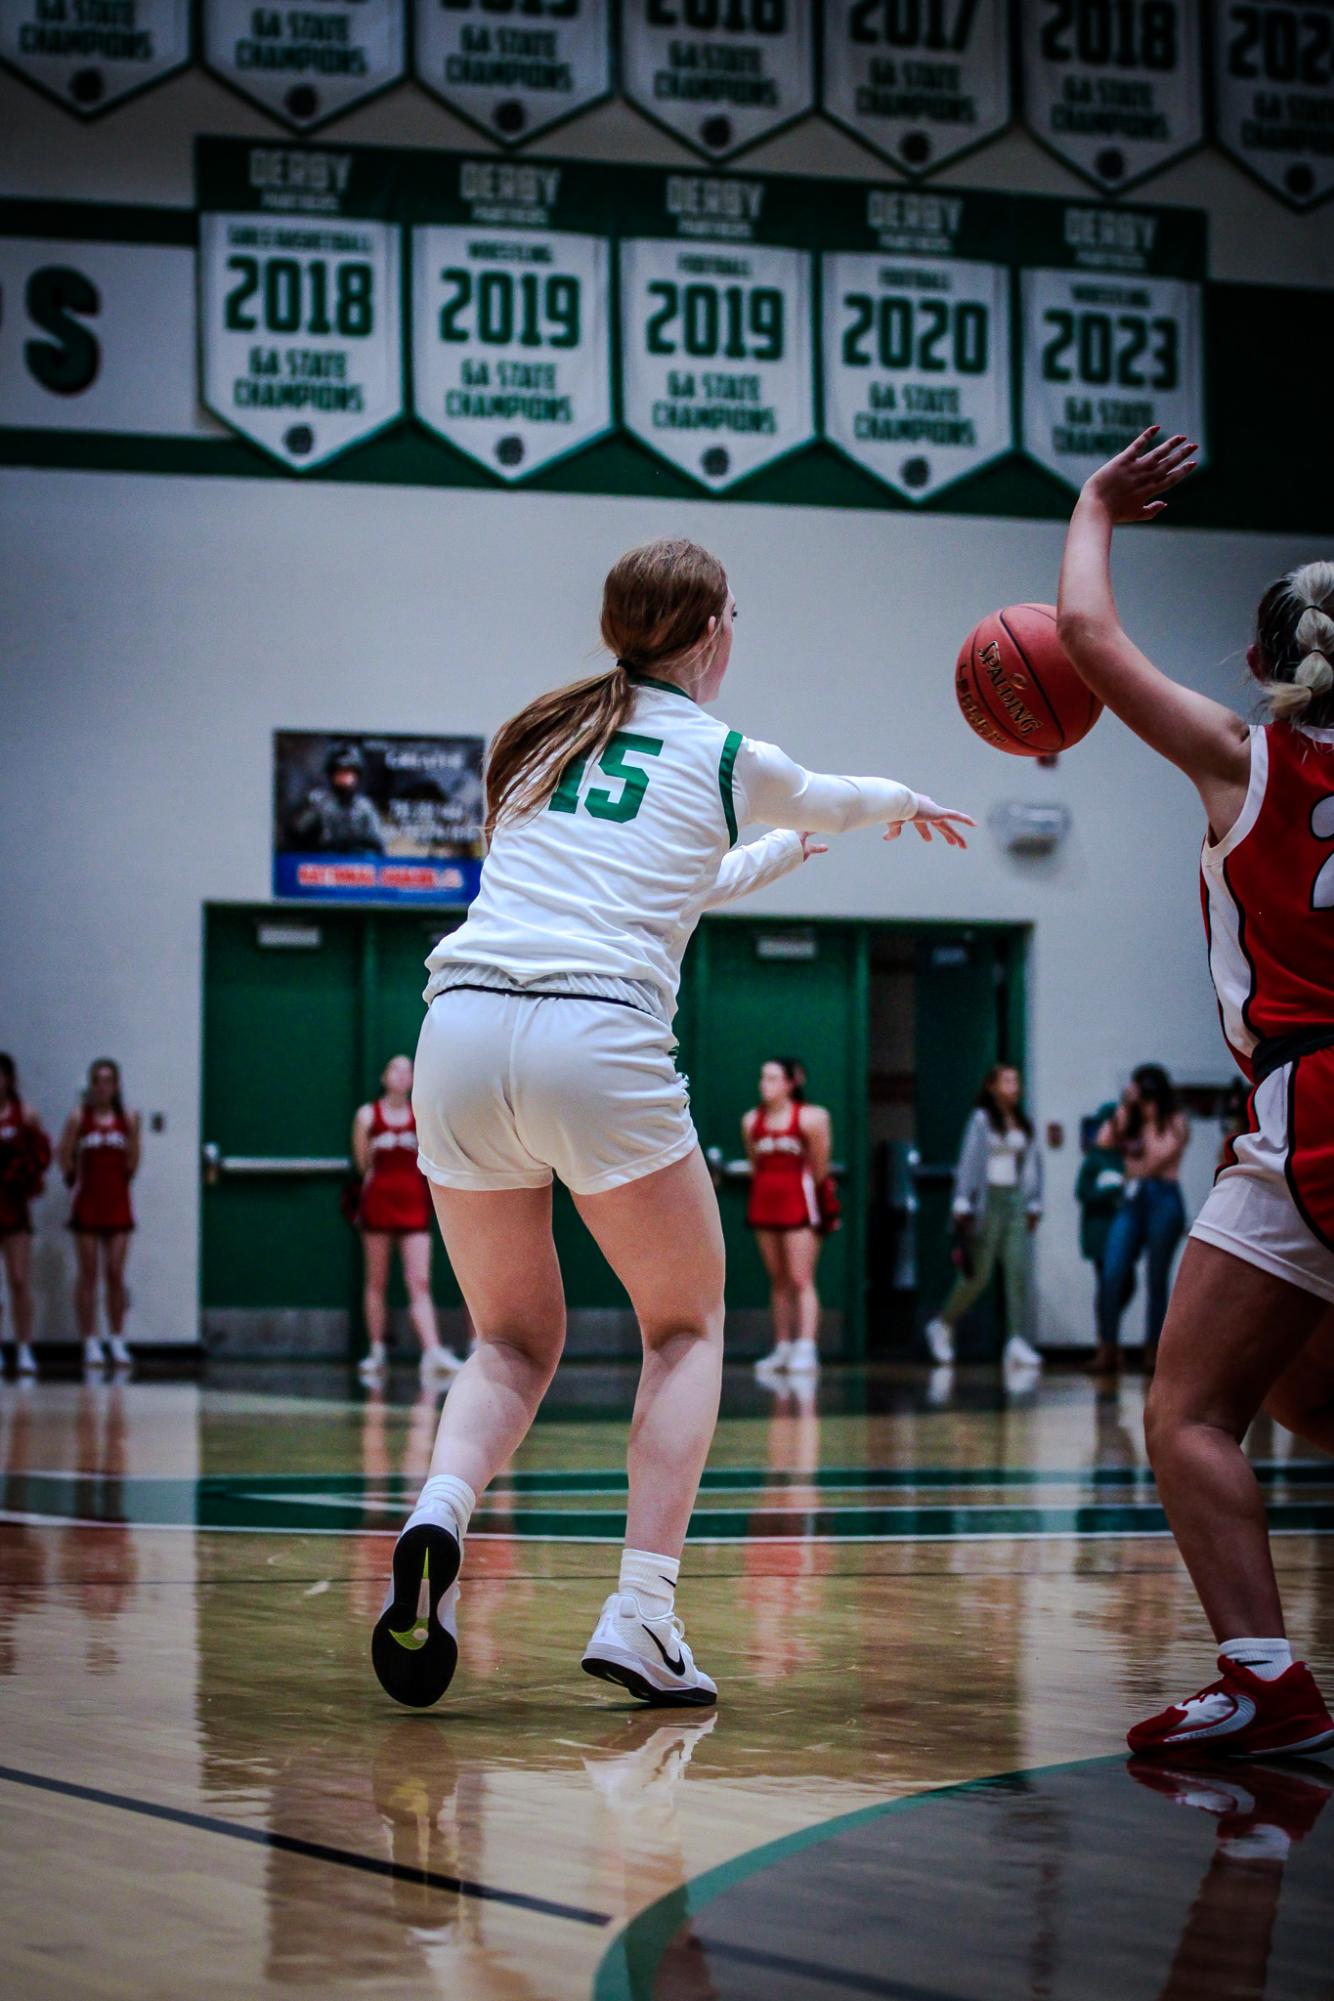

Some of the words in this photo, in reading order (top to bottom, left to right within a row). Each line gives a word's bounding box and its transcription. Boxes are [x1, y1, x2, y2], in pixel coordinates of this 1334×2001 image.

[1042, 0, 1176, 69] 2018
[1230, 6, 1334, 86] 202
[248, 148, 354, 194] DERBY
[459, 161, 561, 204] DERBY
[666, 175, 765, 220] DERBY
[866, 189, 965, 233] DERBY
[1063, 206, 1160, 251] DERBY
[225, 255, 373, 337] 2018
[439, 267, 580, 349] 2019
[646, 280, 784, 362] 2019
[842, 293, 988, 375] 2020
[286, 349, 347, 379] STATE
[1042, 310, 1179, 391] 2023
[234, 379, 363, 413] CHAMPIONS
[497, 361, 557, 391] STATE
[700, 372, 761, 402] STATE
[446, 389, 574, 424] CHAMPIONS
[652, 401, 777, 435] CHAMPIONS
[901, 384, 960, 414] STATE
[854, 413, 976, 447] CHAMPIONS
[977, 640, 1043, 736] SPALDING
[548, 731, 664, 824] 15
